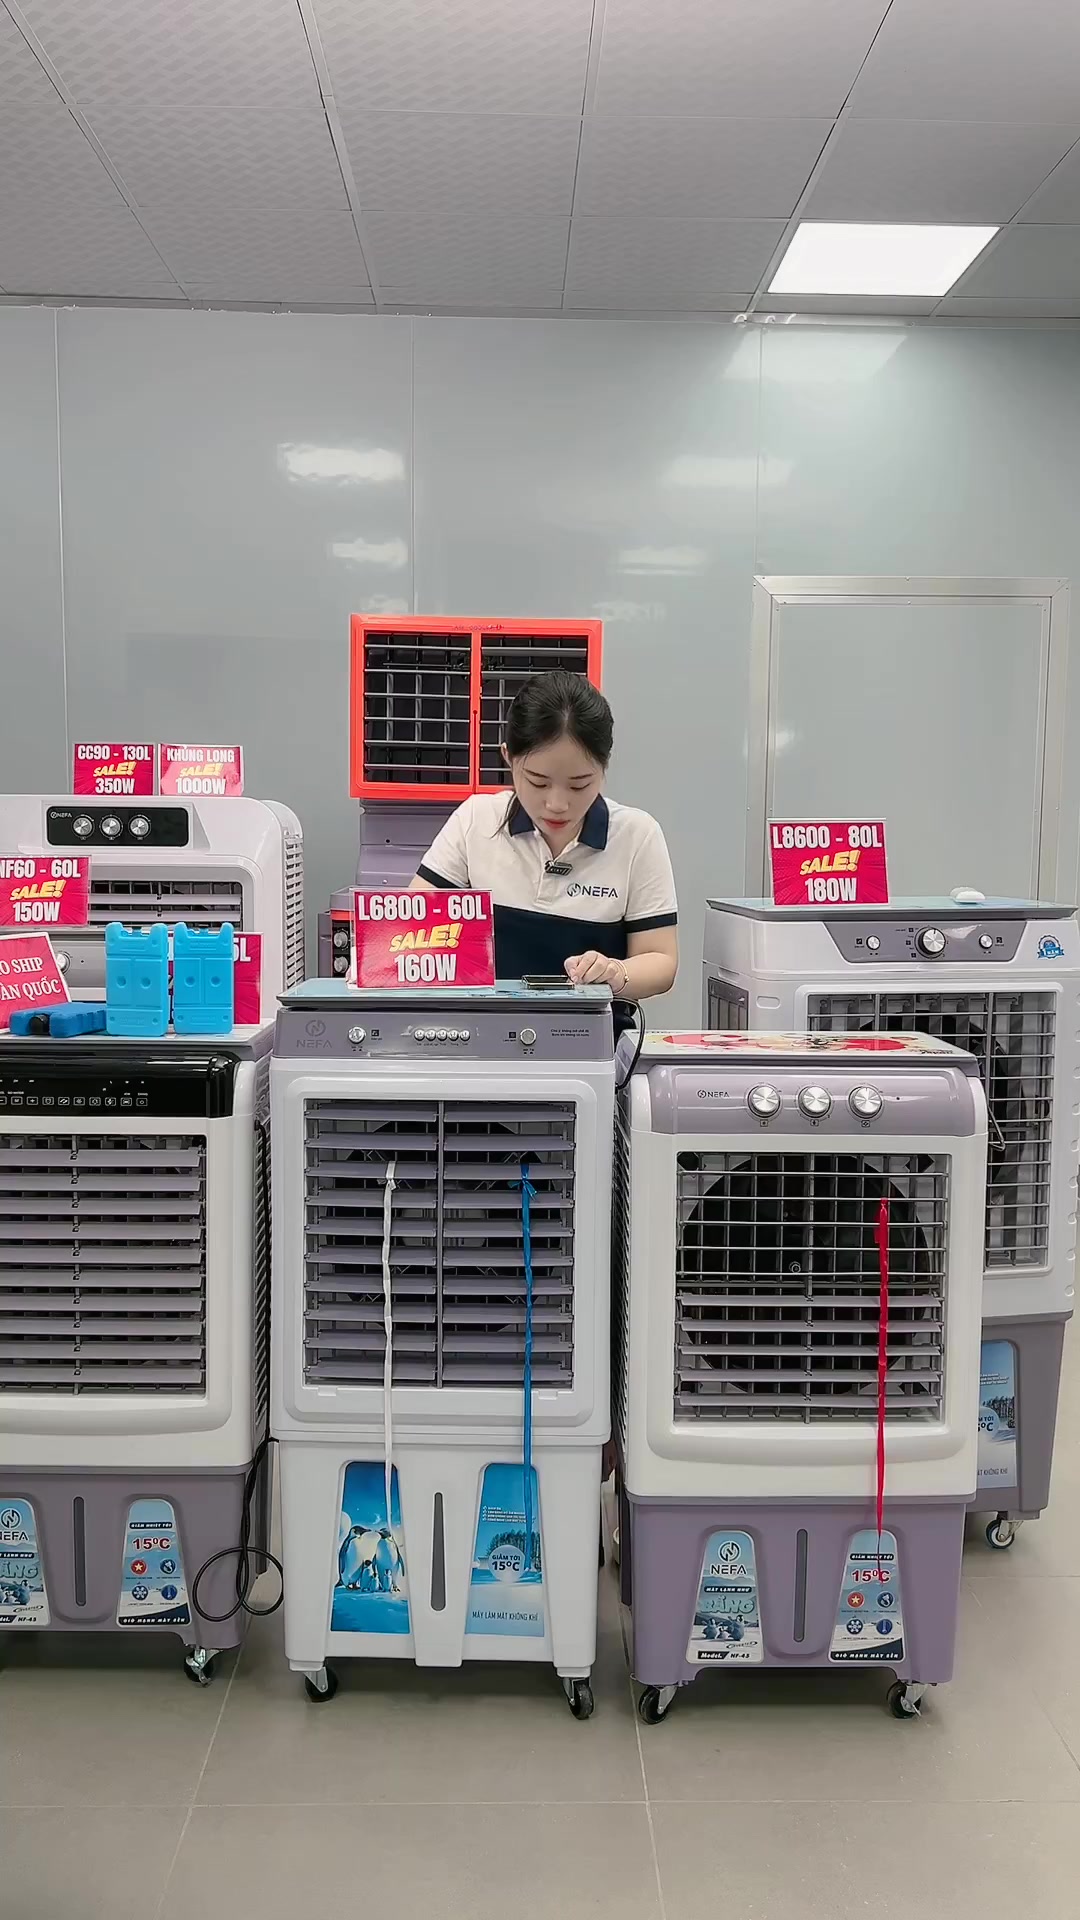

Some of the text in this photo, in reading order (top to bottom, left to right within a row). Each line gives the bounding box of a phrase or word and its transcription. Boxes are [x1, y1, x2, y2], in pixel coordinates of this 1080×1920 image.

[77, 745, 110, 760] CC90
[122, 745, 151, 761] 130L
[206, 749, 235, 763] LONG
[92, 761, 137, 777] SALE!
[179, 763, 224, 777] SALE!
[95, 778, 135, 794] 350W
[176, 778, 226, 795] 1000W
[772, 826, 830, 849] L8600
[848, 825, 882, 848] 80L
[51, 859, 81, 878] 60L
[799, 849, 861, 875] SALE!
[9, 879, 67, 901] SALE!
[582, 886, 618, 898] NEFA
[805, 877, 857, 902] 180W
[12, 901, 60, 922] 150W
[358, 895, 426, 921] L6800
[448, 894, 487, 920] 60L
[389, 922, 464, 952] SALE!
[11, 957, 43, 973] SHIP
[394, 953, 457, 982] 160W
[22, 976, 61, 1001] QUỐC
[296, 1040, 332, 1048] NEFA
[711, 1565, 747, 1575] NEFA
[700, 1595, 755, 1614] BĂNG
